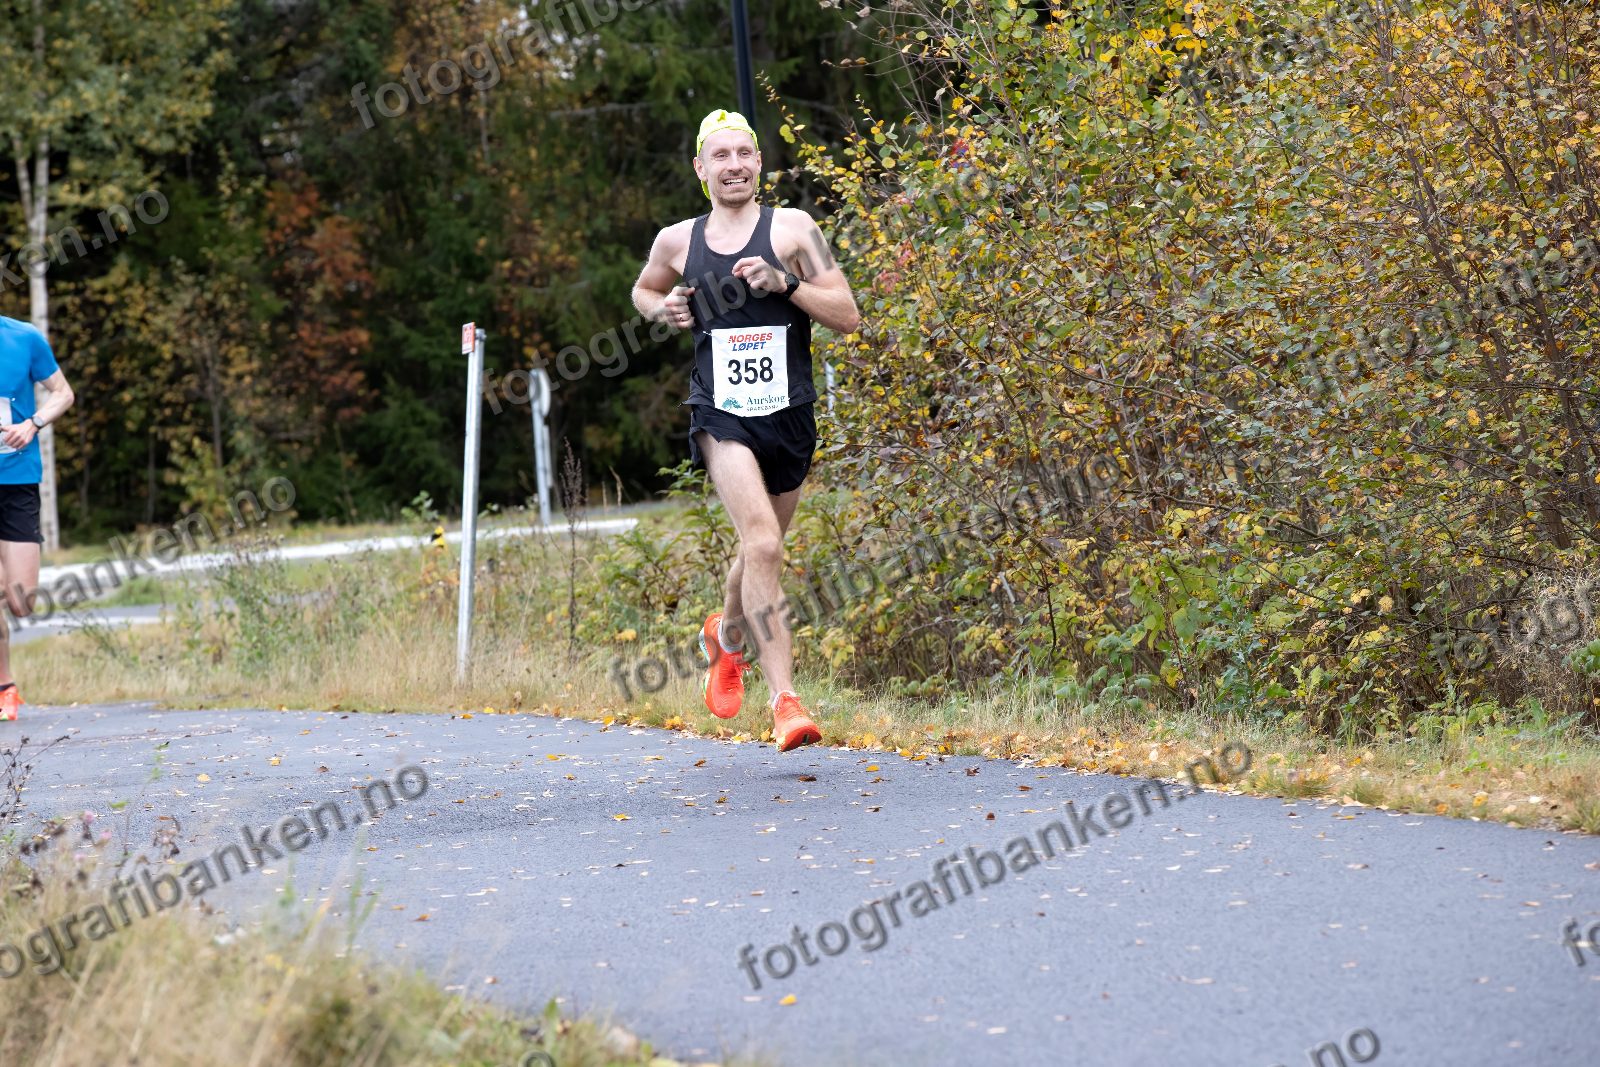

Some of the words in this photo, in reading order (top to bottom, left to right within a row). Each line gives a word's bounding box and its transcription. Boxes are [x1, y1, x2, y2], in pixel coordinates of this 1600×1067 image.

[728, 333, 773, 343] NORGES
[732, 342, 766, 351] LØPET
[727, 356, 774, 385] 358
[746, 394, 786, 405] Aurskog
